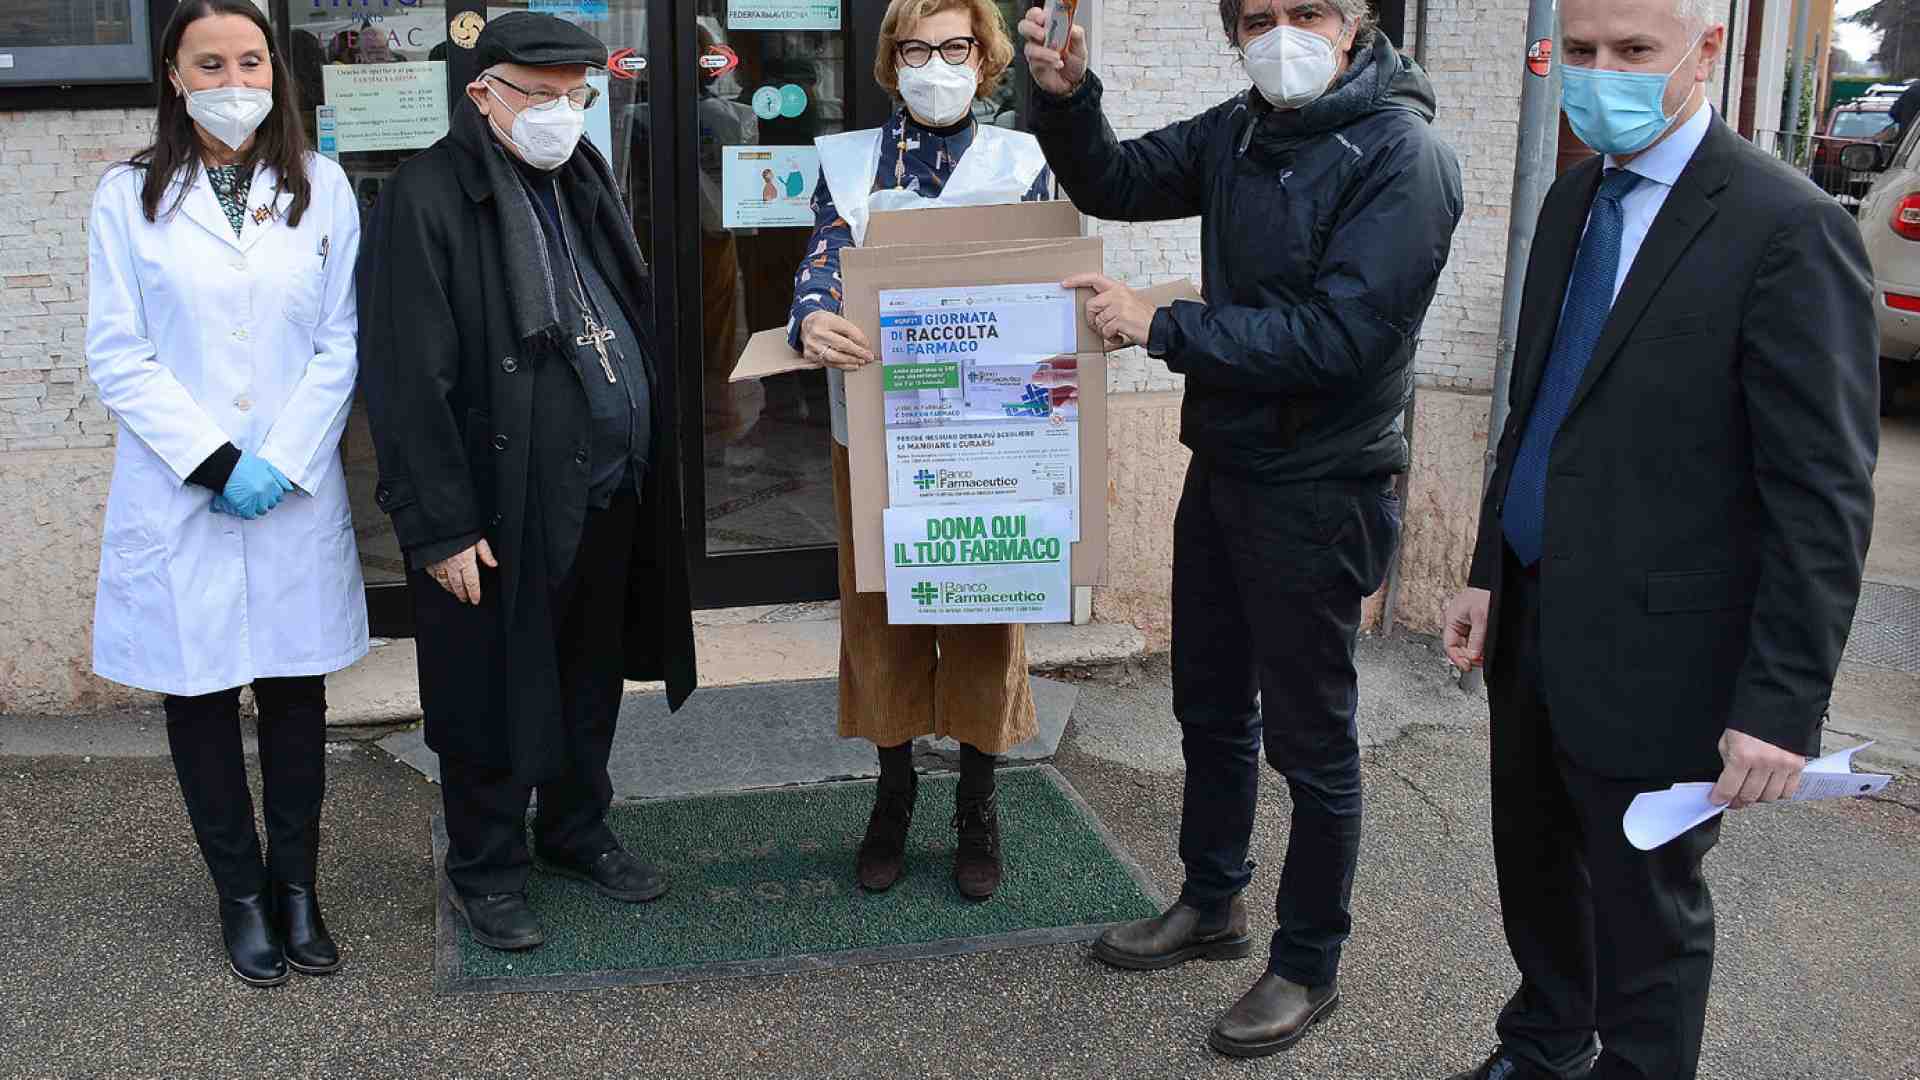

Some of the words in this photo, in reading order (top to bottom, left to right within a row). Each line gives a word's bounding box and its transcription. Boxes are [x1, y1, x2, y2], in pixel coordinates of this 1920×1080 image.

[925, 311, 997, 325] GIORNATA
[891, 331, 903, 341] DI
[906, 325, 999, 342] RACCOLTA
[907, 340, 978, 354] FARMACO
[940, 469, 972, 479] Banco
[940, 476, 1018, 489] Farmaceutico
[927, 516, 987, 541] DONA
[991, 515, 1026, 538] QUI
[894, 543, 912, 564] IL
[914, 541, 956, 564] TUO
[960, 538, 1060, 563] FARMACO
[945, 581, 987, 592] Banco
[945, 590, 1046, 604] Farmaceutico
